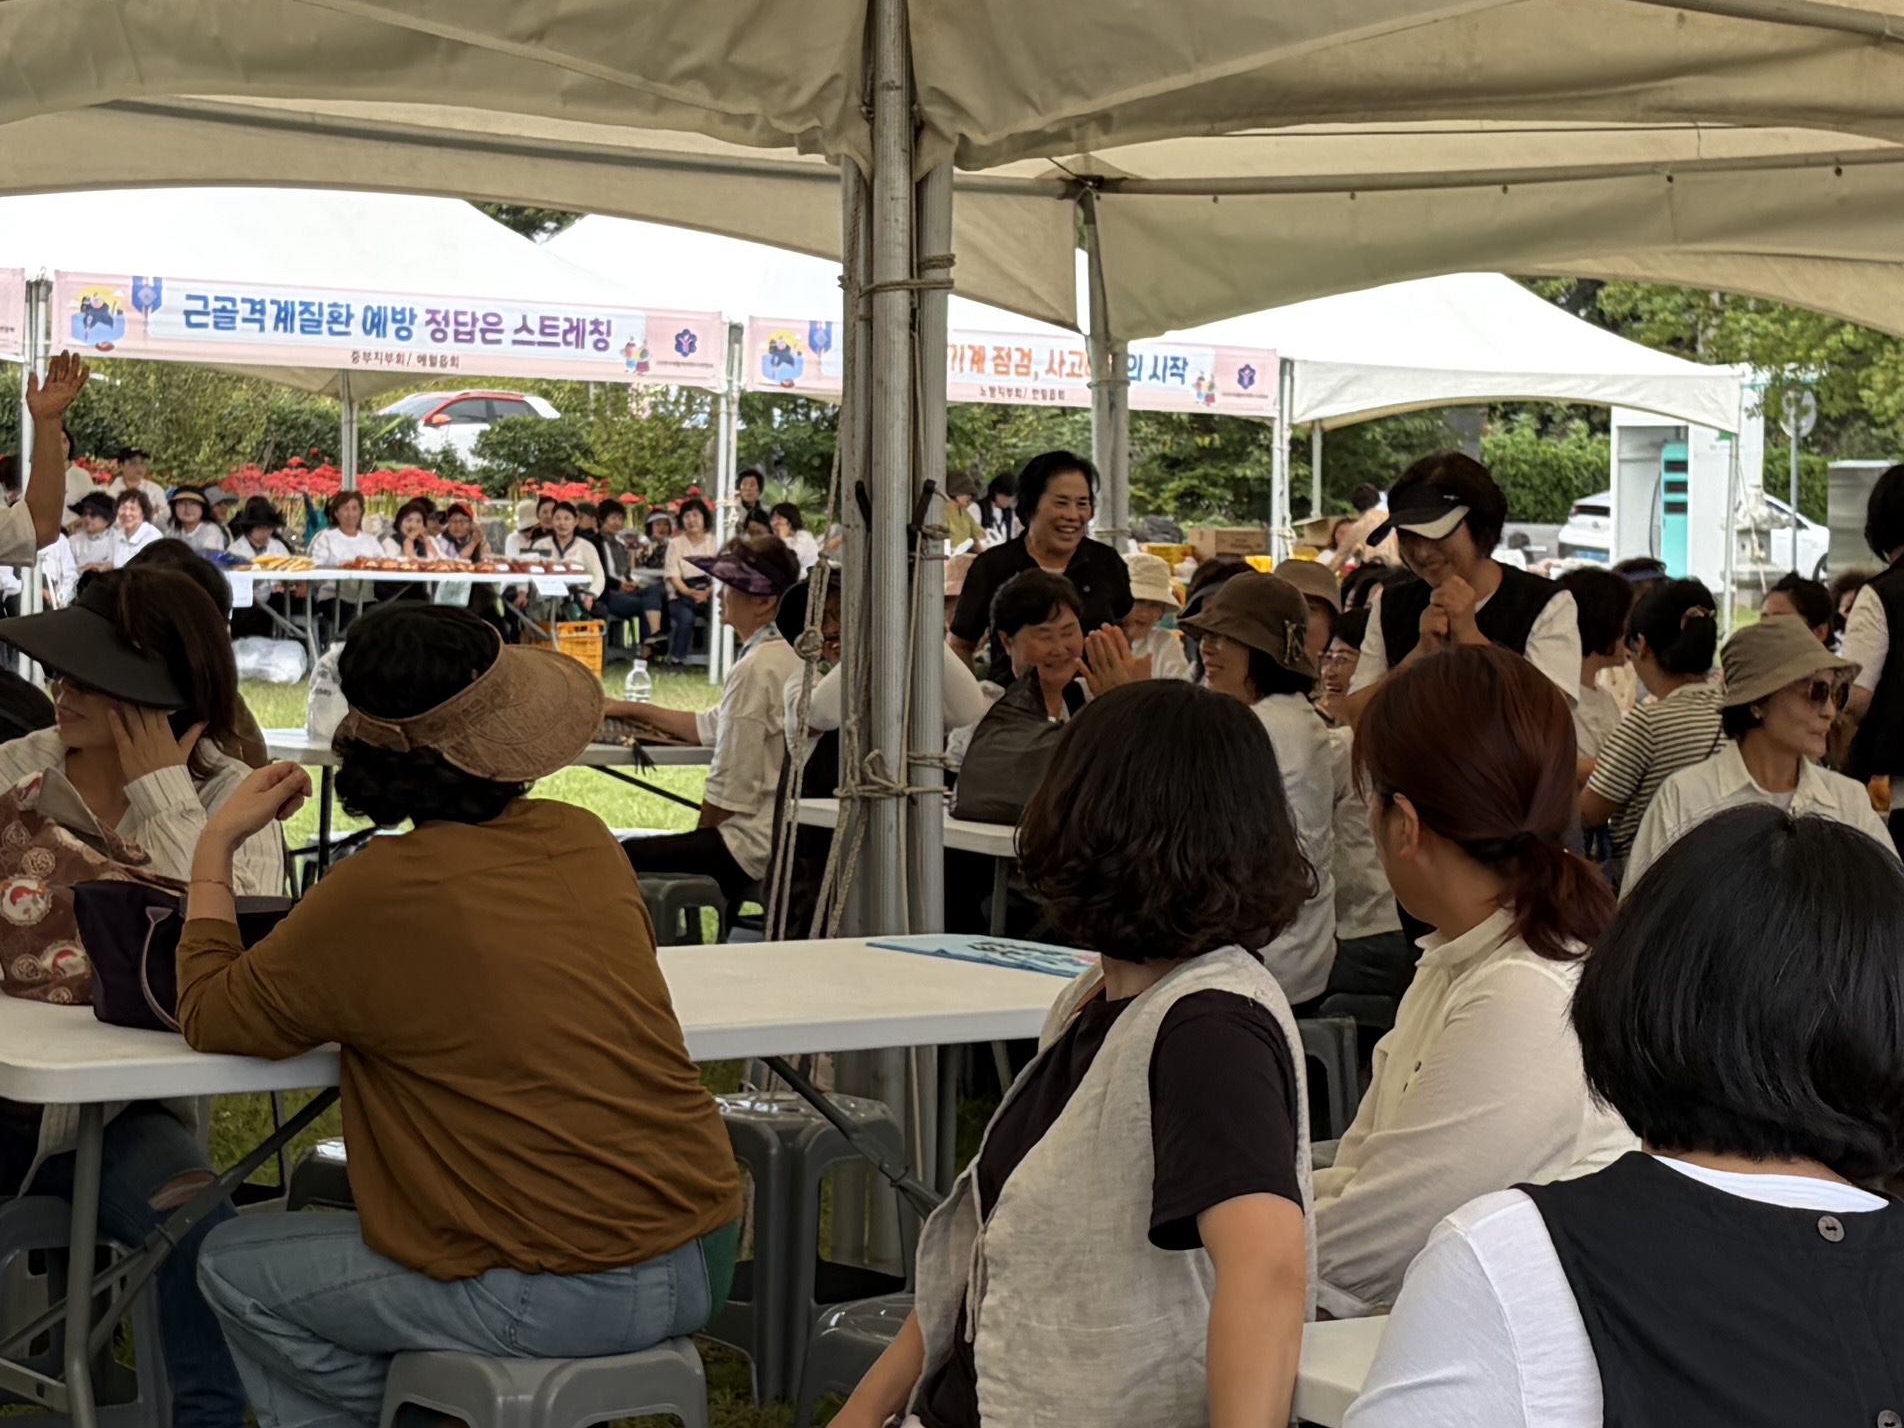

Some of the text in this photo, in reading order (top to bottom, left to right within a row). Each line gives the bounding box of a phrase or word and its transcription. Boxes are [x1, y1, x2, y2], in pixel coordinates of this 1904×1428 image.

[182, 294, 612, 353] 근골격계질환 예방 정답은 스트레칭
[948, 344, 985, 373] 기계
[992, 347, 1039, 381] 점검,
[1149, 355, 1189, 385] 시작
